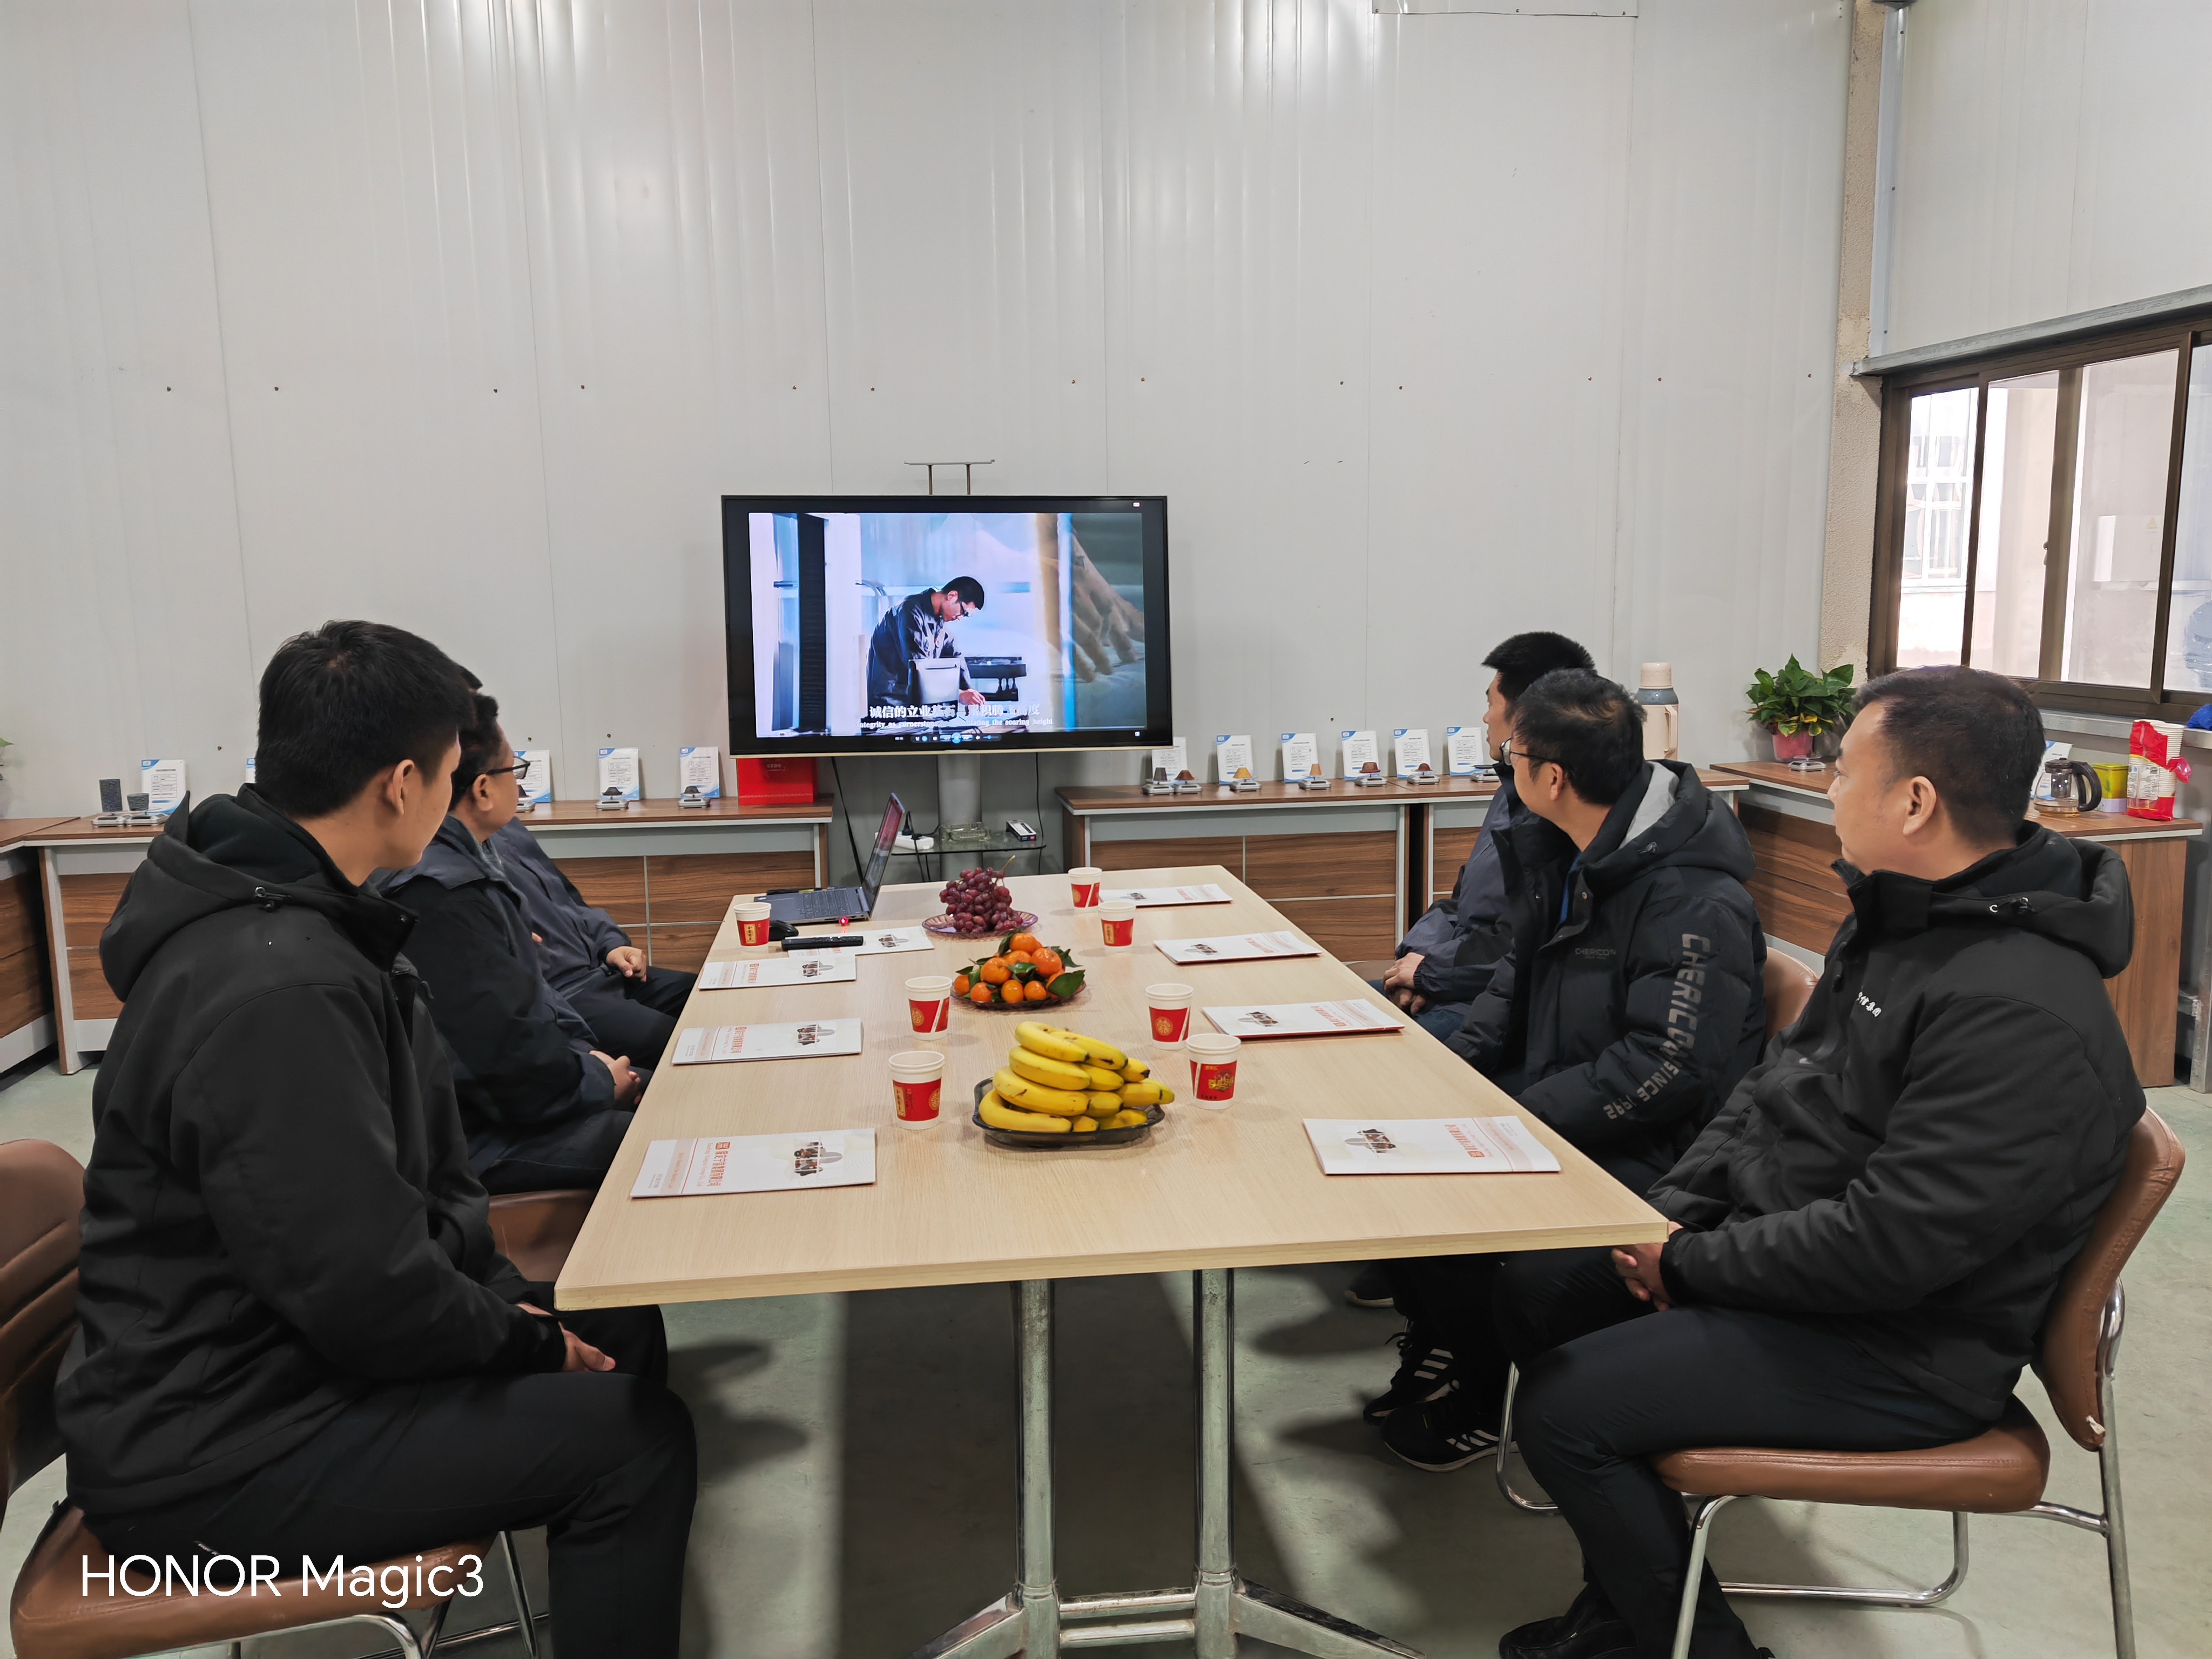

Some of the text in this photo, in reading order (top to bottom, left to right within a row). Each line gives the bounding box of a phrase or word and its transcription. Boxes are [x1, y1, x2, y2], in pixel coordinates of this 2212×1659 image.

[857, 721, 886, 729] Integrity
[1005, 718, 1030, 726] soaring
[1033, 718, 1053, 726] height
[1603, 1061, 1680, 1120] SINCE 1992
